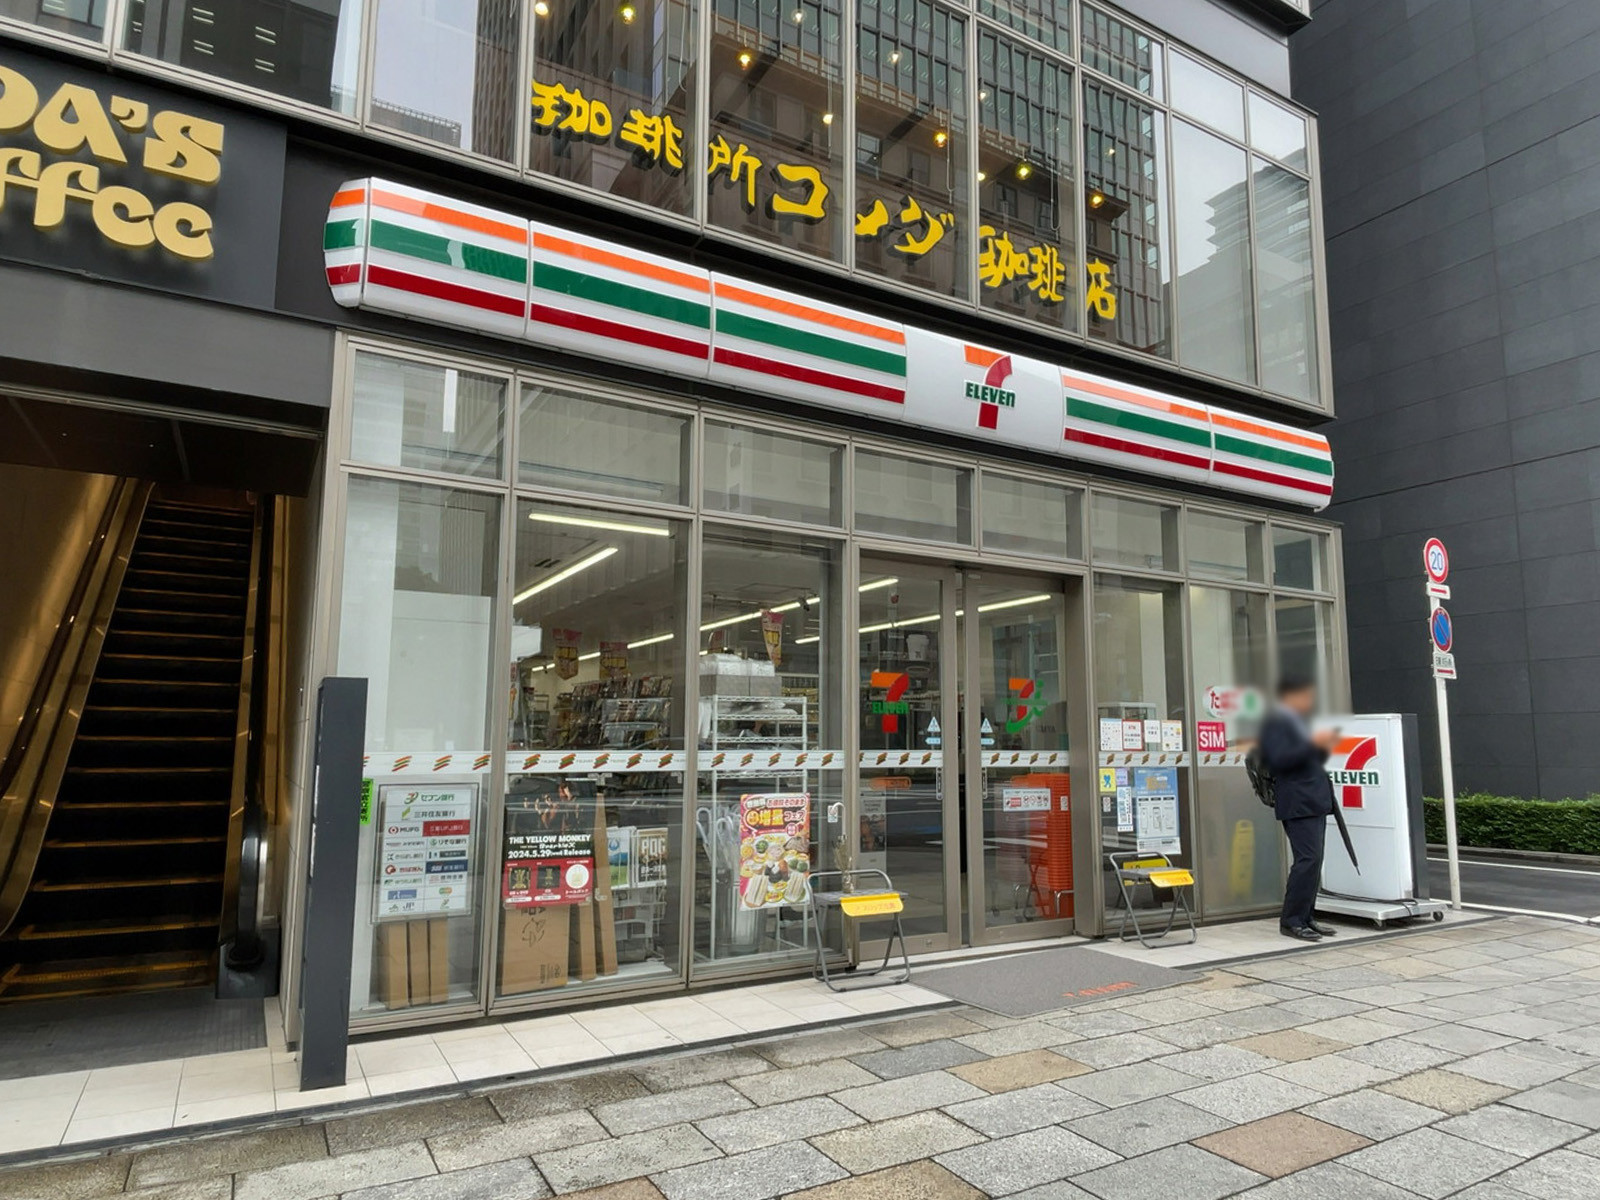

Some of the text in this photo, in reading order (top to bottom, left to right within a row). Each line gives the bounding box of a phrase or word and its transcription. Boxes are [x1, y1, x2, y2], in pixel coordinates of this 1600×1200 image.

[1430, 551, 1443, 570] 20
[1200, 731, 1225, 748] SIM
[509, 834, 591, 844] THE YELLOW MONKEY
